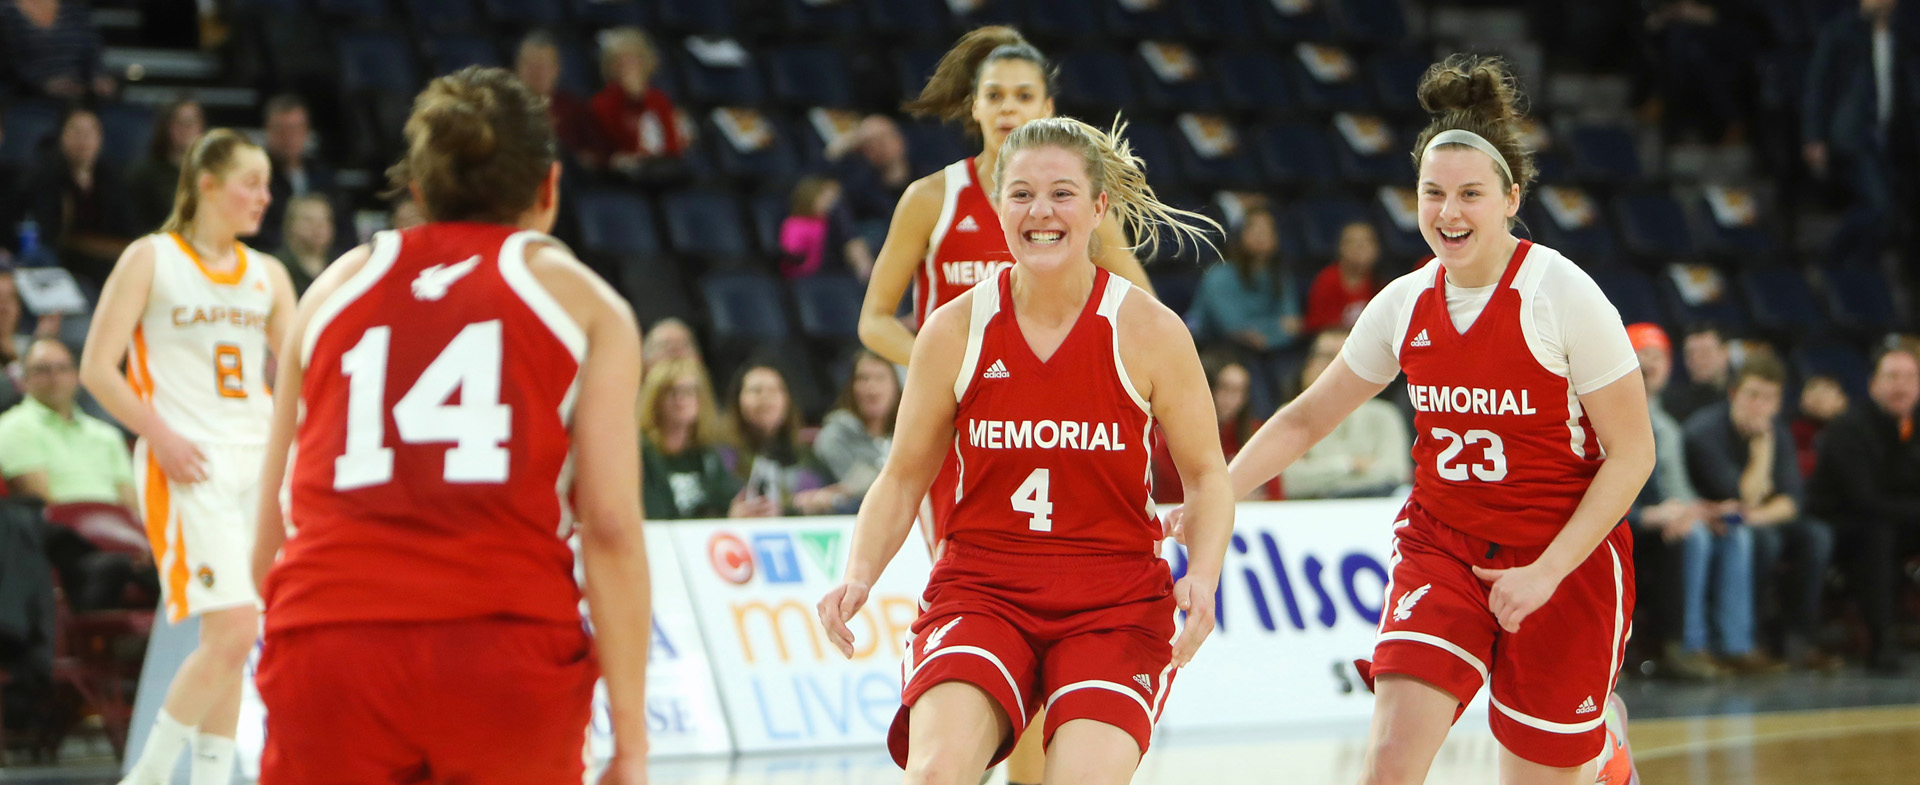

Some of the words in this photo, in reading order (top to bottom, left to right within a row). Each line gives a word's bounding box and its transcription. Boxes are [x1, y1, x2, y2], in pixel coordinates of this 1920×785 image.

[942, 260, 1014, 286] MEM
[983, 371, 1010, 379] adidas
[334, 319, 511, 490] 14
[1406, 383, 1537, 416] MEMORIAL
[968, 418, 1126, 451] MEMORIAL
[1430, 427, 1508, 482] 23
[1010, 467, 1053, 532] 4
[708, 531, 841, 585] CTV
